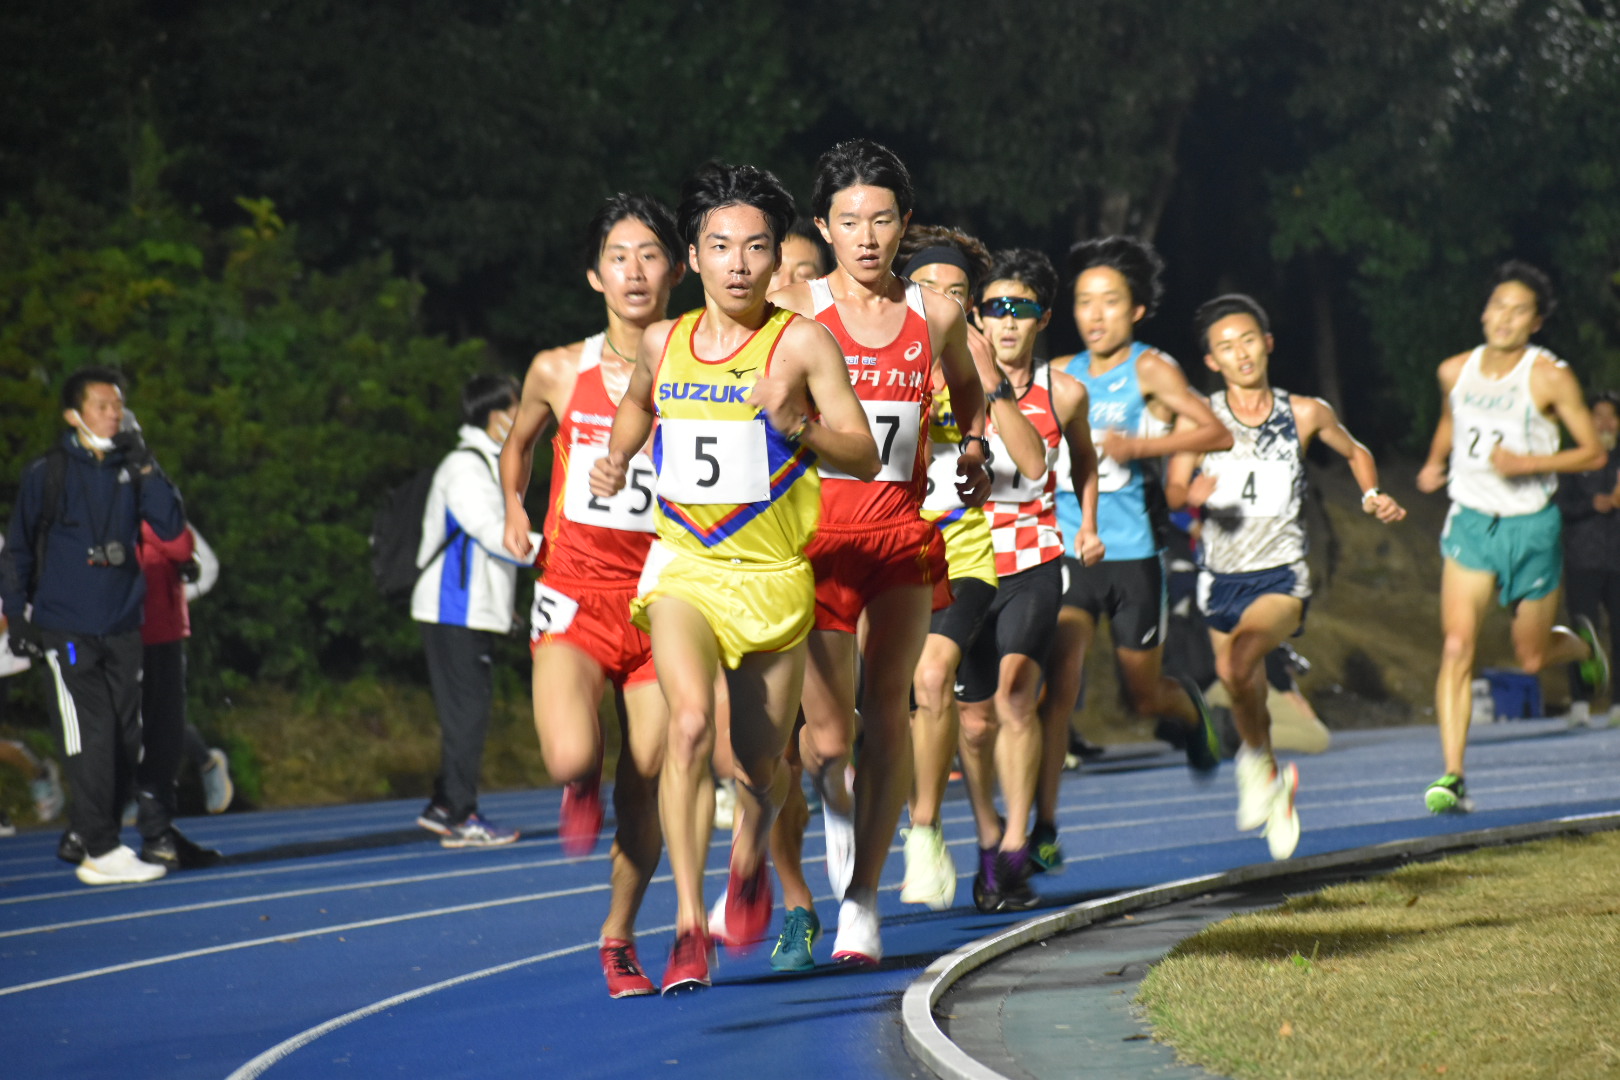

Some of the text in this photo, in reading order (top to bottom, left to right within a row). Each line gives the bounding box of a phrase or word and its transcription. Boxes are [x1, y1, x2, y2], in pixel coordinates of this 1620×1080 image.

[659, 382, 750, 404] SUZUK
[876, 415, 900, 466] 7
[695, 436, 720, 488] 5
[1242, 471, 1257, 505] 4
